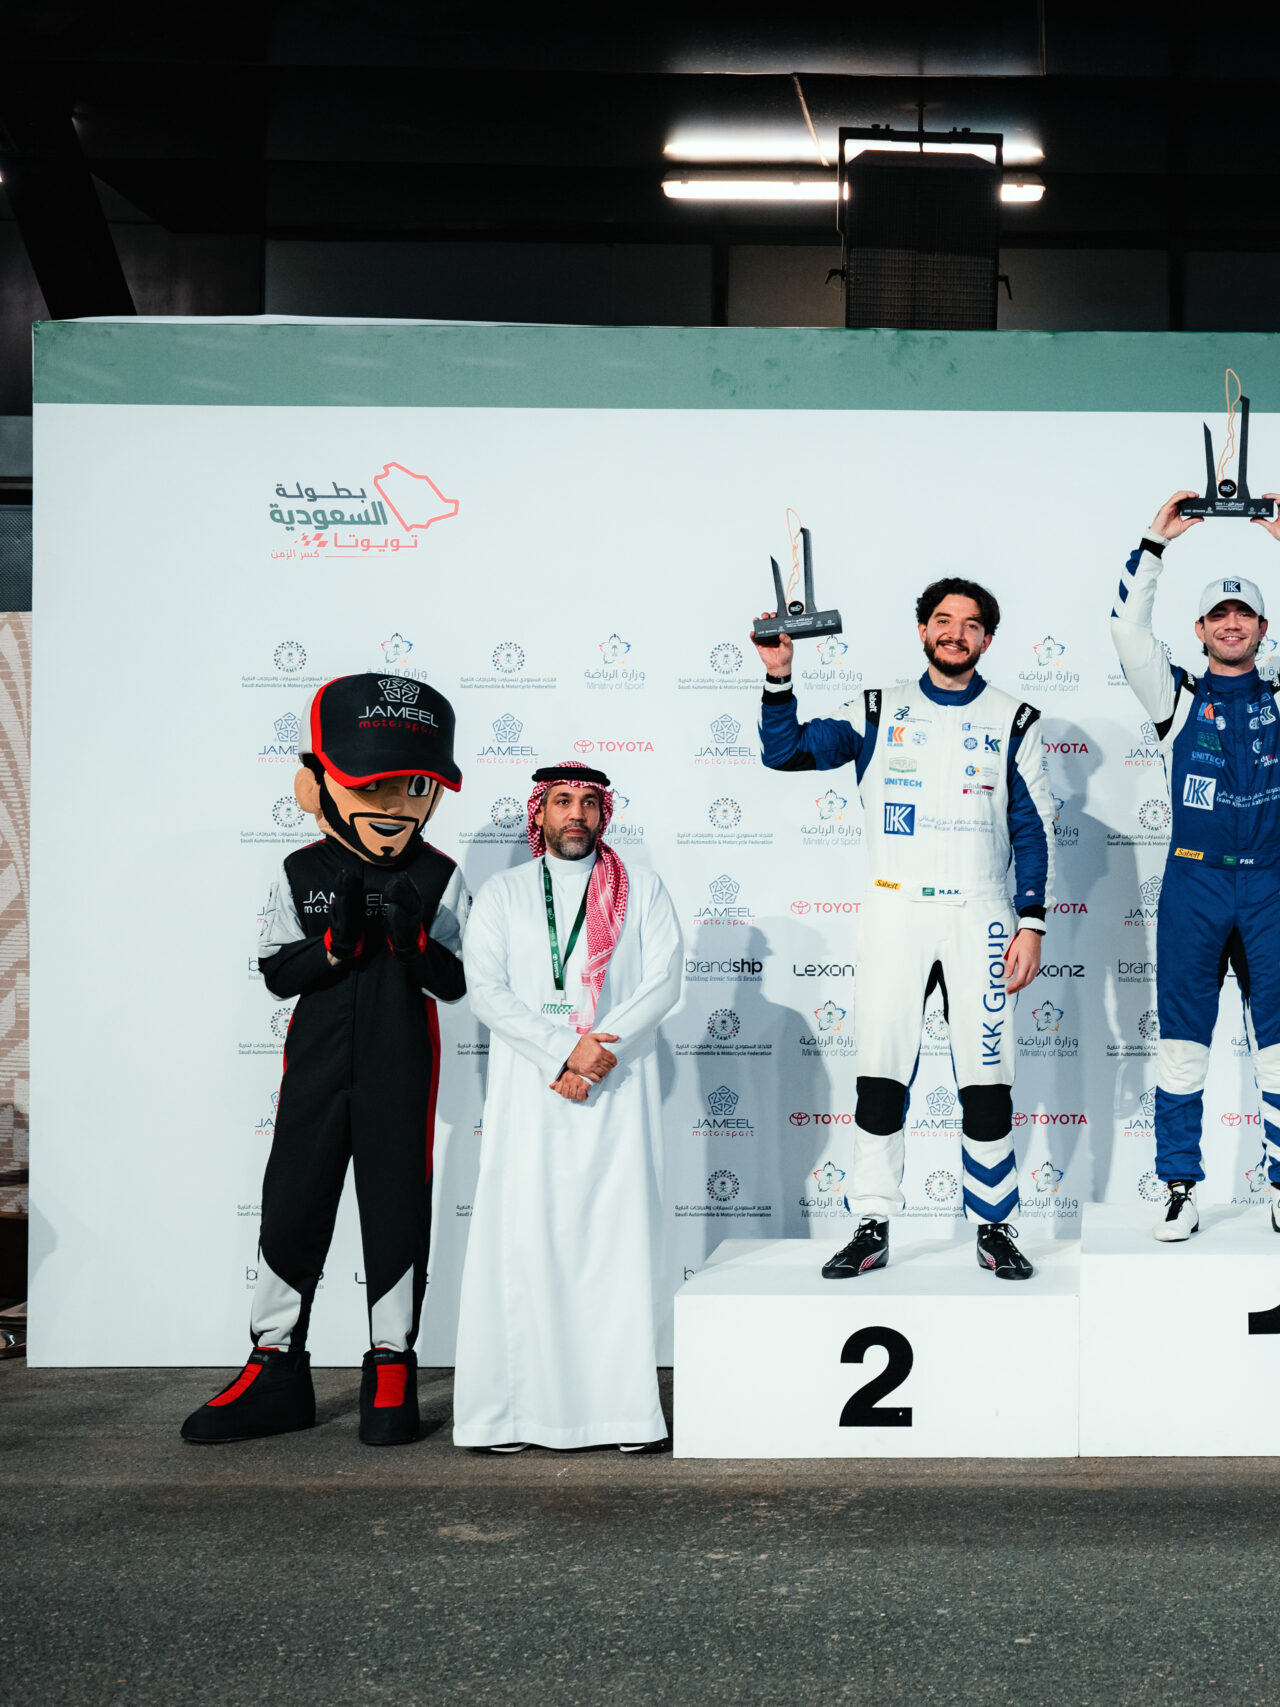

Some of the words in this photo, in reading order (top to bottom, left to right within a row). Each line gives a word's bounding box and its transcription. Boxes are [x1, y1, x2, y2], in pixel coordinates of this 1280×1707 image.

[276, 482, 367, 503] بطولة
[269, 501, 388, 531] السعودية
[334, 532, 418, 552] تويوتا
[271, 549, 296, 560] الزمن
[584, 669, 617, 680] الرياضة
[622, 669, 644, 681] وزارة
[802, 670, 835, 680] الرياضة
[839, 670, 862, 682] وزارة
[1019, 670, 1052, 682] الرياضة
[1056, 670, 1079, 683] وزارة
[358, 705, 439, 728] JAMEEL
[359, 719, 438, 737] motorsport
[258, 745, 299, 755] JAME
[477, 745, 538, 756] JAMEEL
[597, 741, 654, 752] TOYOTA
[695, 746, 756, 757] JAMEEL
[1044, 743, 1088, 754] OYOTA
[1125, 749, 1158, 758] JAM
[694, 758, 757, 766] motorsport
[884, 777, 922, 788] UNITECH
[801, 824, 834, 836] الرياضة
[838, 824, 861, 837] وزارة
[694, 907, 755, 917] JAMEEL
[814, 902, 861, 913] TOYOT
[1054, 903, 1088, 914] YOTA
[694, 918, 756, 926] motorsport
[983, 921, 1008, 1012] Group
[1038, 964, 1085, 978] xonz
[983, 1019, 1004, 1066] IKK
[1018, 1036, 1051, 1047] الرياضة
[1055, 1036, 1078, 1048] وزارة
[692, 1118, 754, 1128] JAMEEL
[813, 1114, 855, 1124] TOYO
[910, 1119, 962, 1129] JAMEE
[1031, 1114, 1087, 1125] TOYOTA
[839, 1326, 914, 1427] 2
